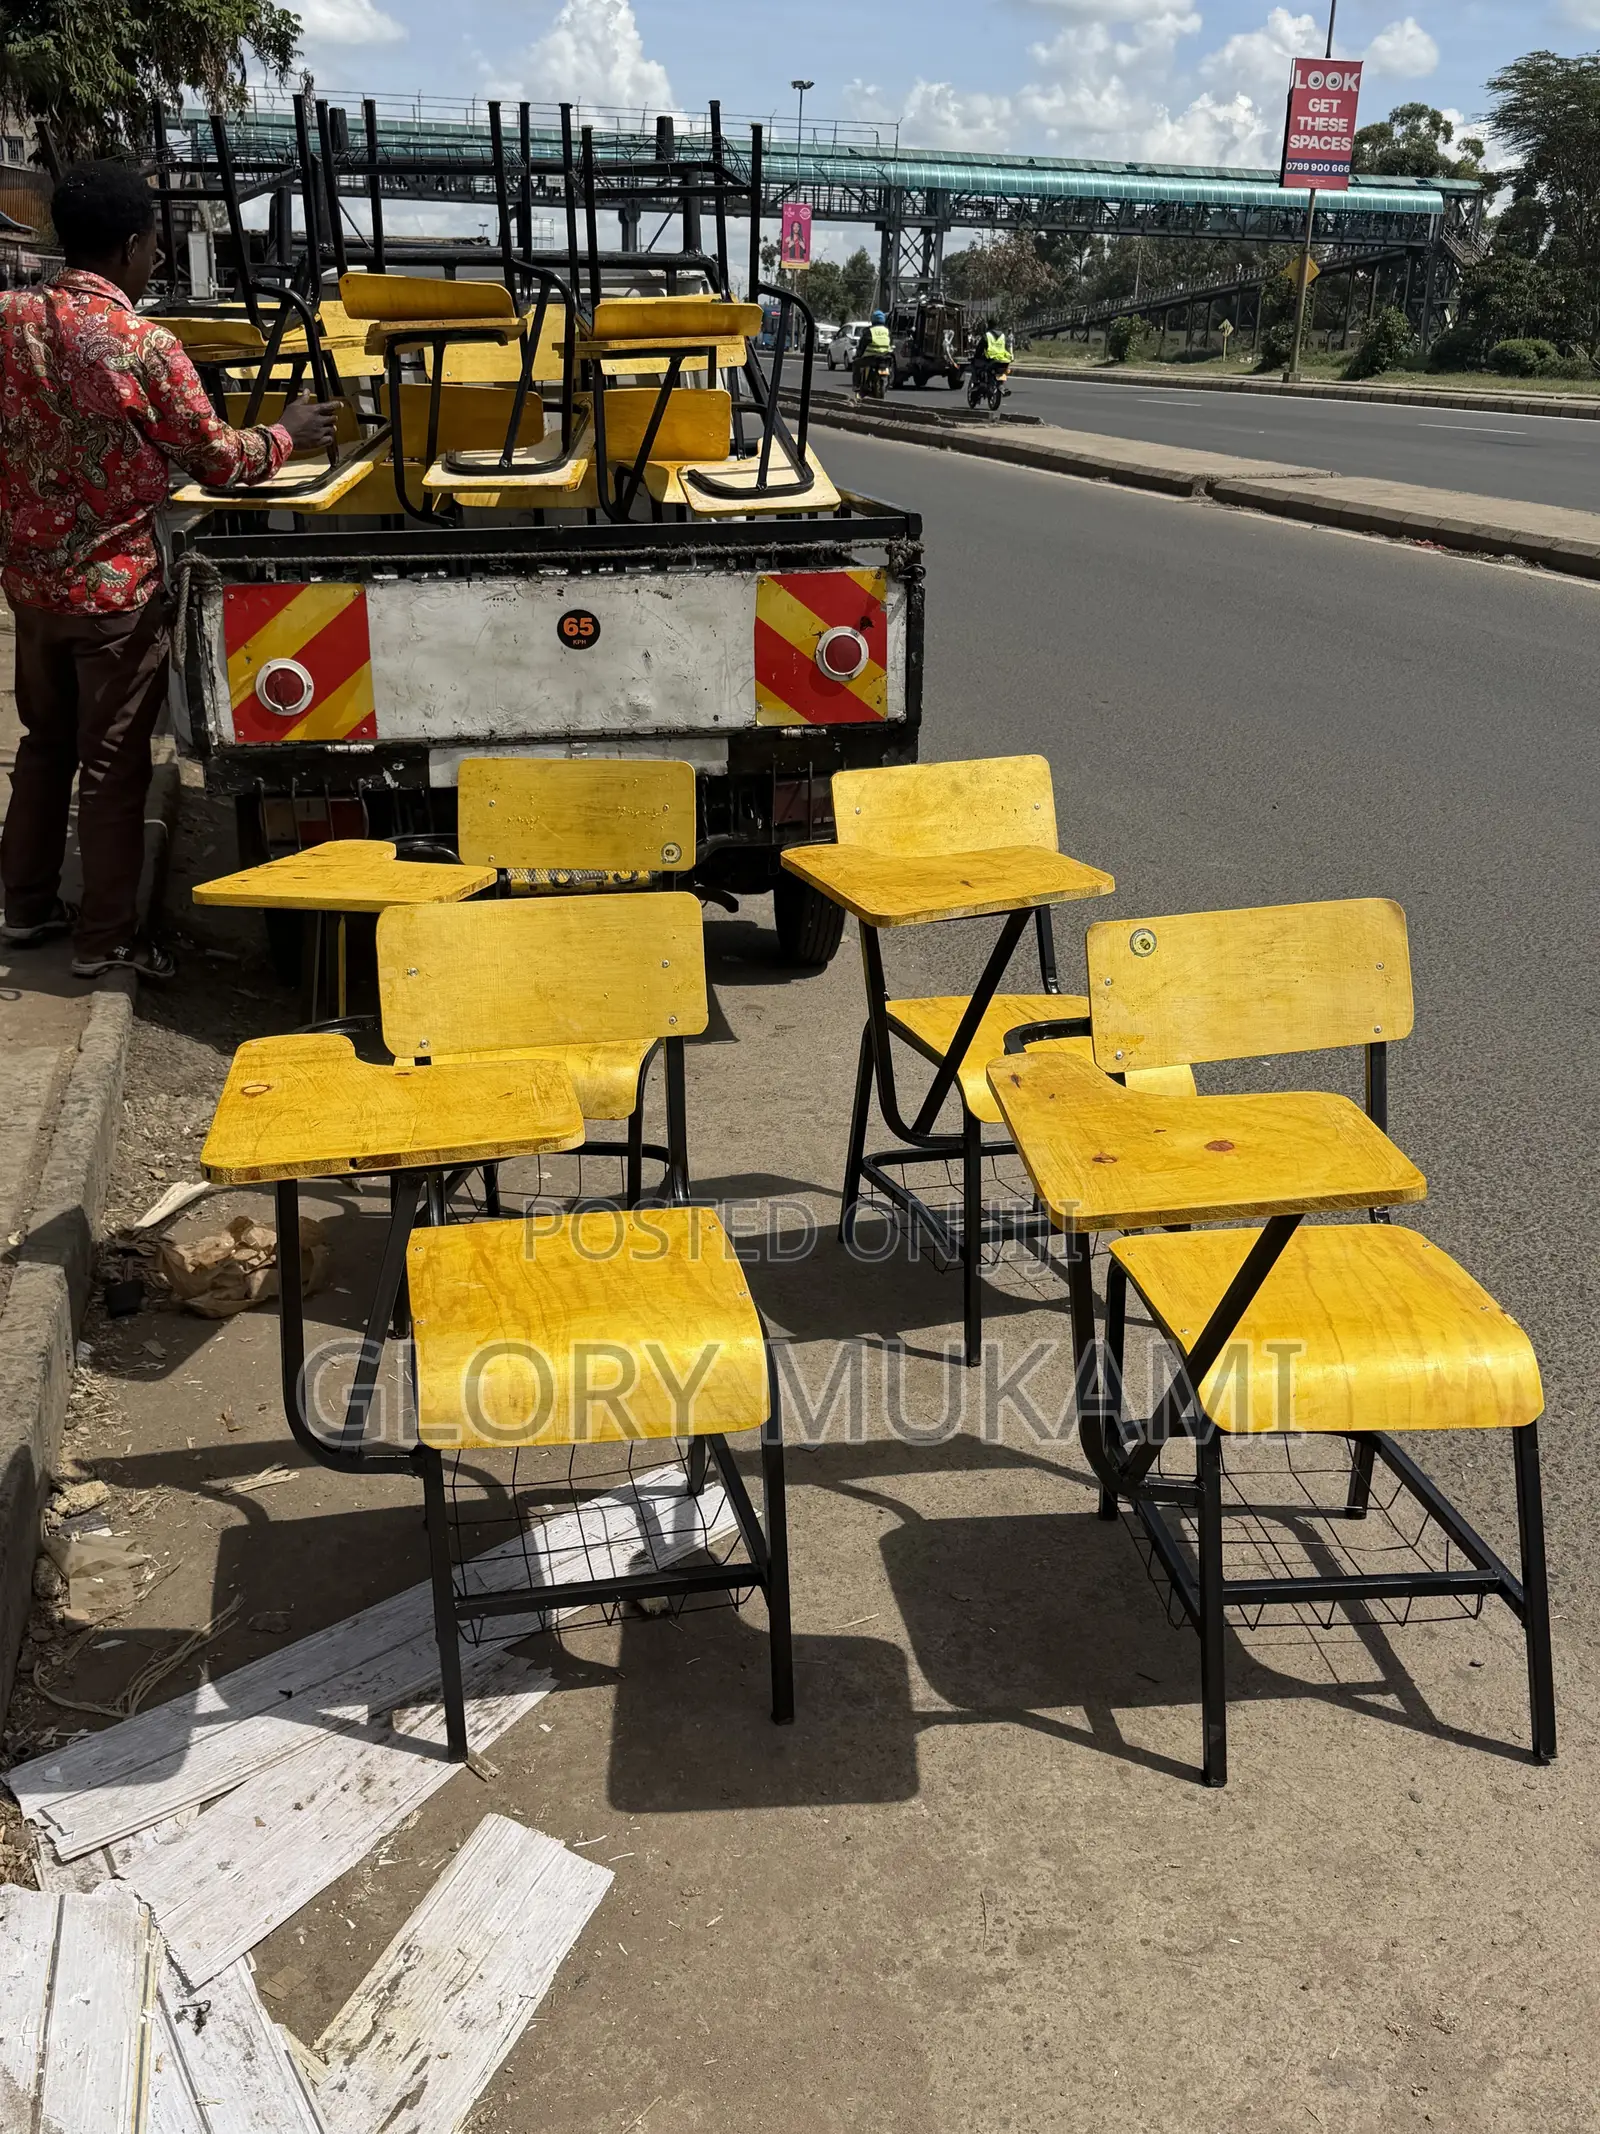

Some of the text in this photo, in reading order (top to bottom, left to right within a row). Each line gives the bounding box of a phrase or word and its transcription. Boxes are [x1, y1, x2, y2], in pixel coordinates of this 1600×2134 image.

[1295, 70, 1360, 92] LOOK
[1309, 98, 1341, 113] GET
[1297, 116, 1348, 132] THESE
[1290, 135, 1352, 151] SPACES
[1286, 162, 1350, 173] 0799 900 666
[563, 617, 594, 636] 65
